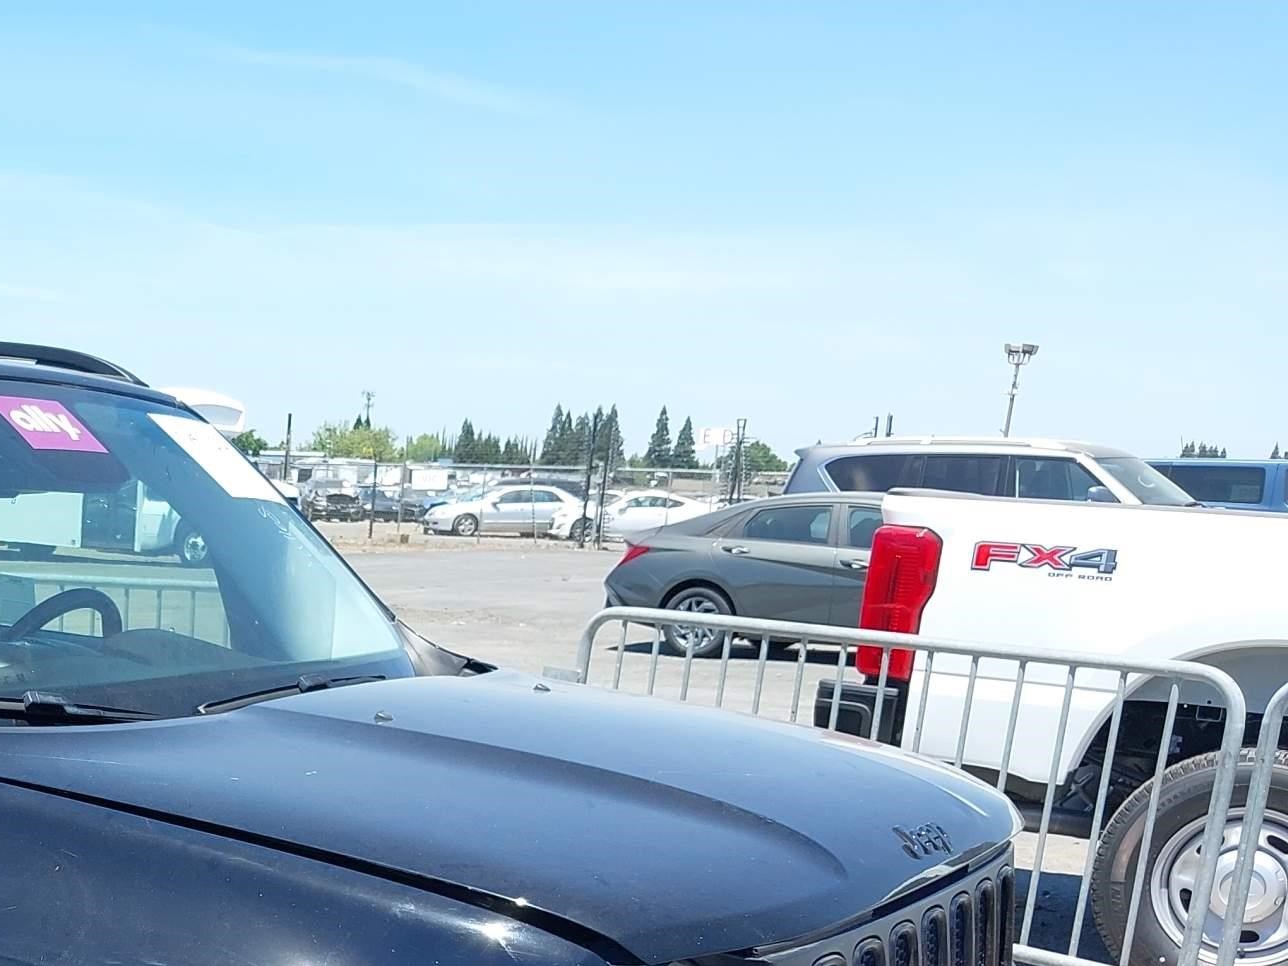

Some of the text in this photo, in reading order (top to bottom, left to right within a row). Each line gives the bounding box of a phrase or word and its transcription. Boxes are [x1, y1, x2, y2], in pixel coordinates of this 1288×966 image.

[9, 403, 83, 440] ally
[970, 541, 1117, 574] FX4
[1078, 574, 1113, 582] ROAD
